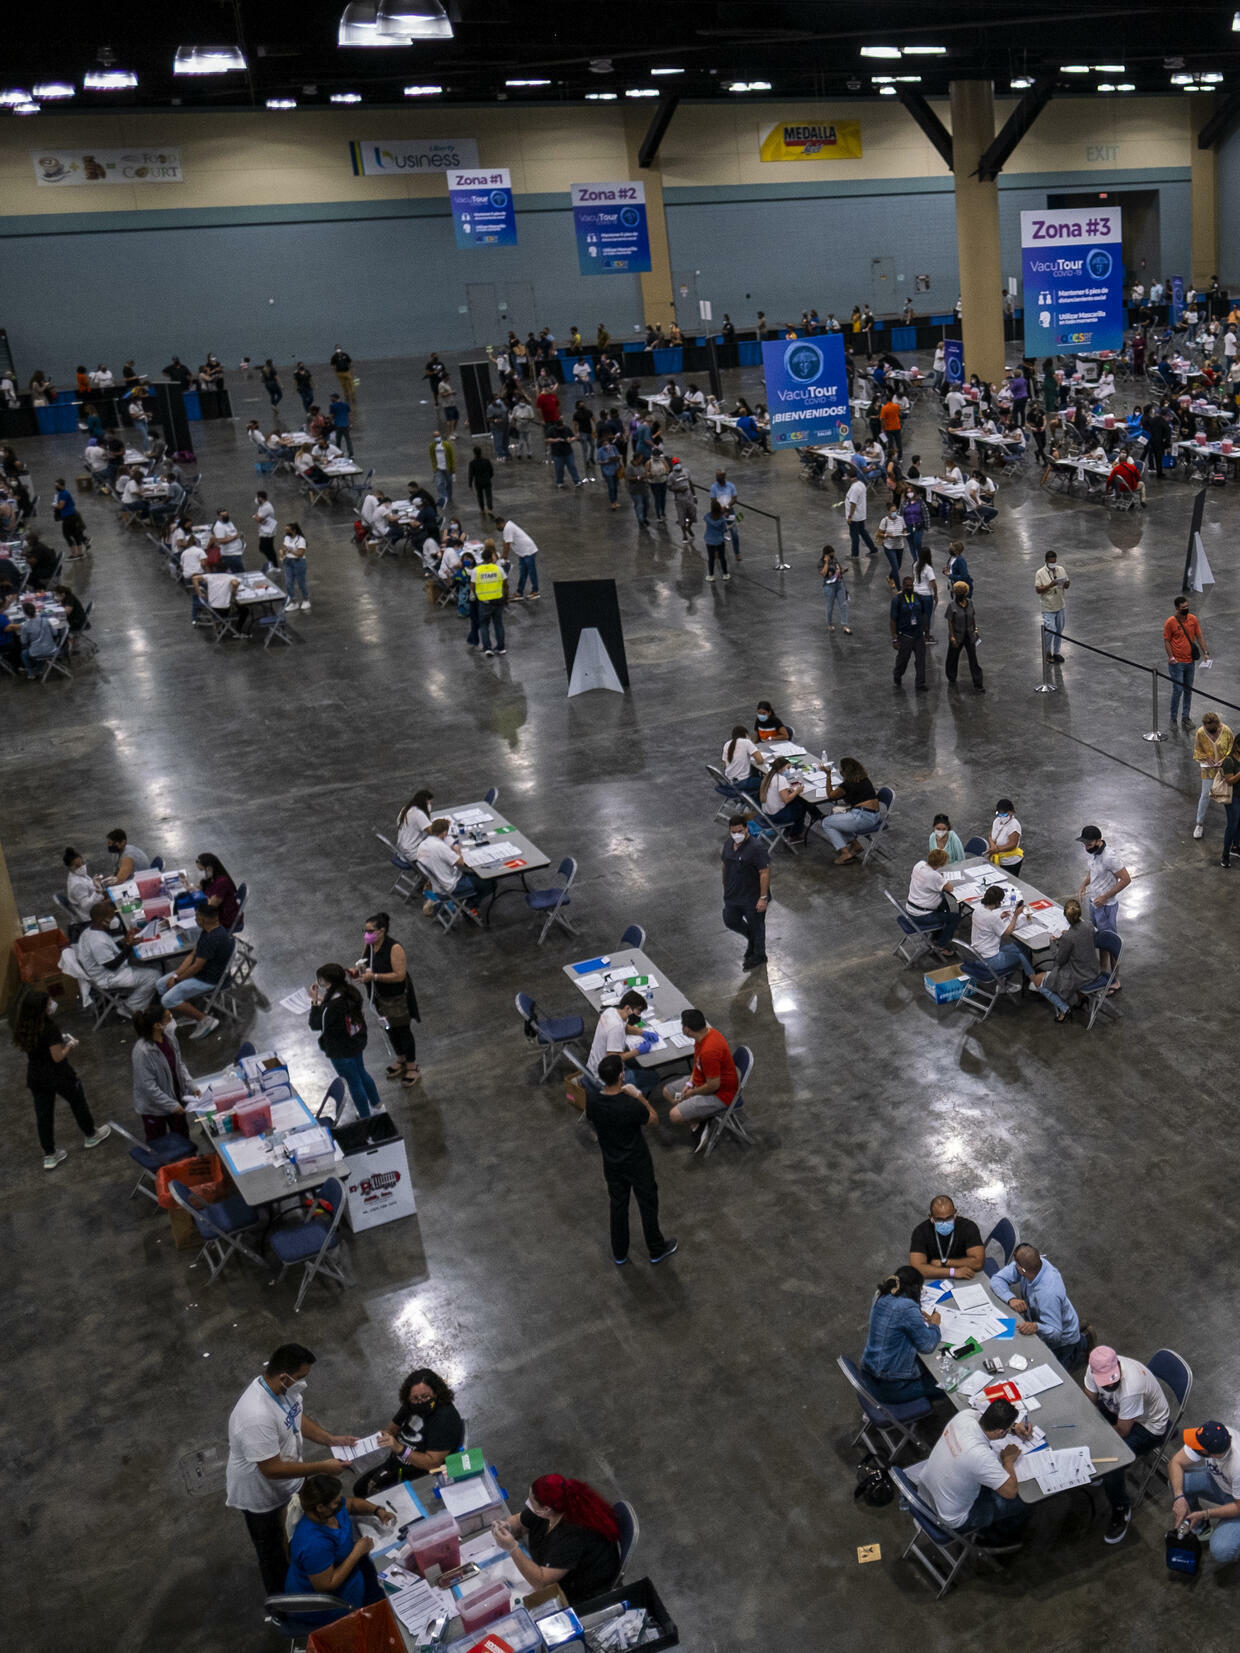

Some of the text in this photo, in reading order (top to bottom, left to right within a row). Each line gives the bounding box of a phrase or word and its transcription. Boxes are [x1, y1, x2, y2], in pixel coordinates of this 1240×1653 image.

[784, 126, 837, 140] MEDALLA
[1086, 143, 1120, 162] EXIT
[122, 166, 178, 179] COURT
[455, 174, 503, 186] Zona #1
[578, 187, 637, 201] Zona #2
[1032, 217, 1111, 239] Zona #3
[1029, 259, 1084, 272] VacuTour
[1052, 270, 1073, 278] COVID
[777, 385, 838, 401] VacuTour
[804, 396, 827, 405] COVID
[772, 405, 847, 424] ¡BIENVENIDOS!
